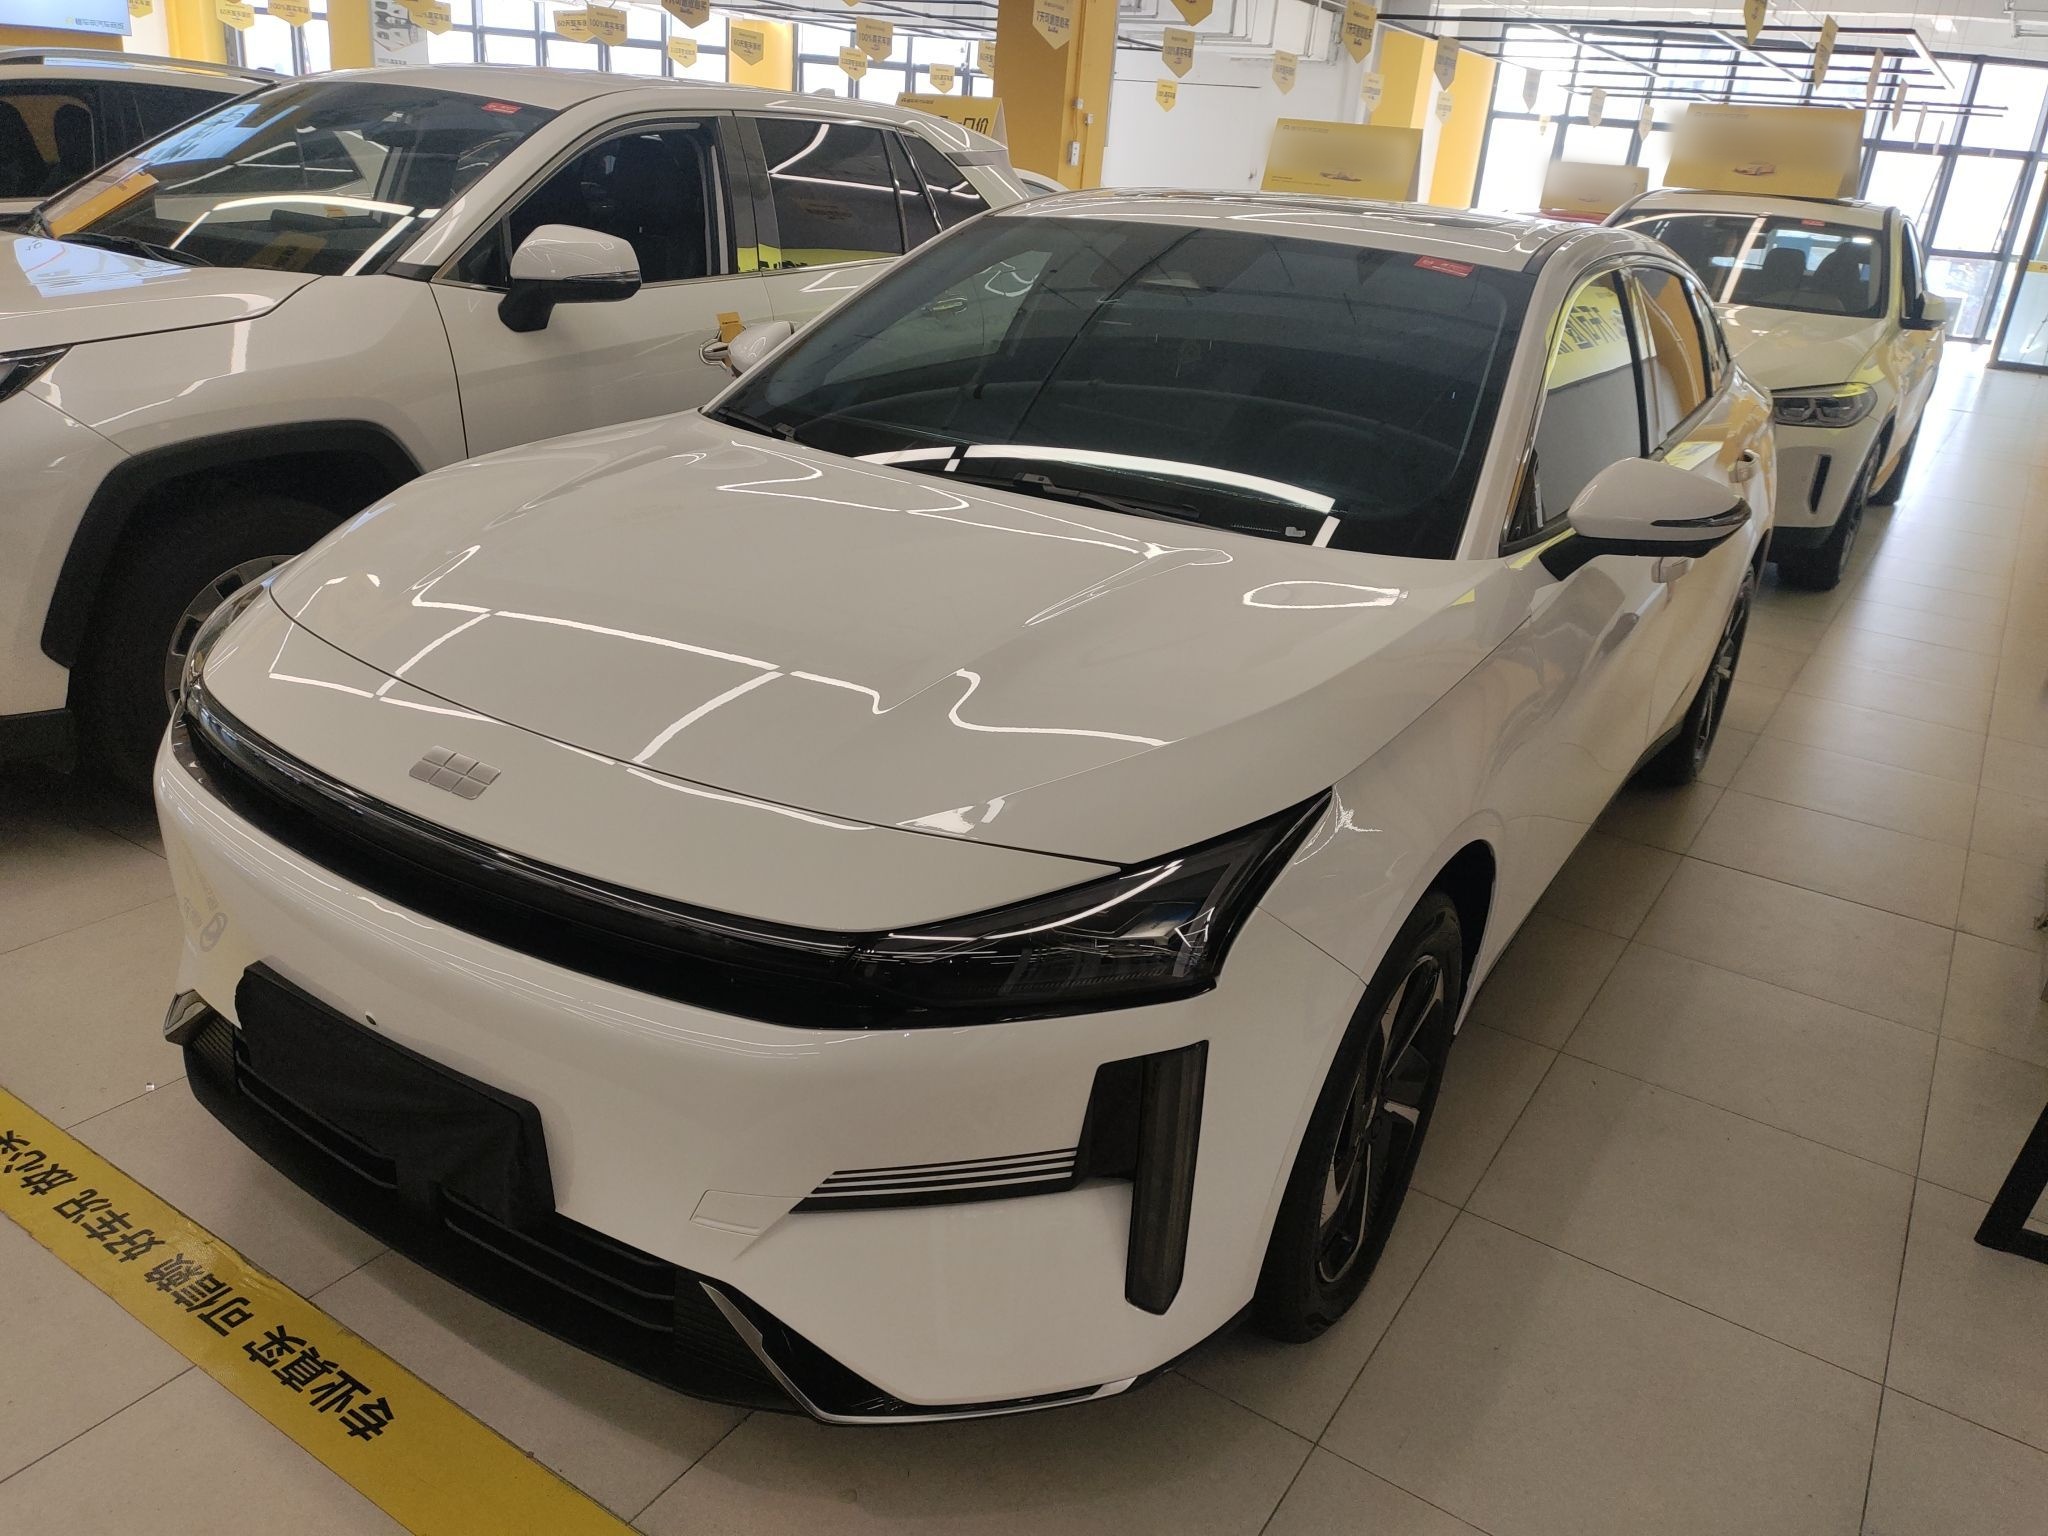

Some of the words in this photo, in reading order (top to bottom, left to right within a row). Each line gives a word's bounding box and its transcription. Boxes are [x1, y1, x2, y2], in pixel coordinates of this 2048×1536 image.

[52, 1188, 166, 1263] 好车况
[143, 1252, 255, 1337] 可信赖
[243, 1324, 396, 1442] 专业真实
